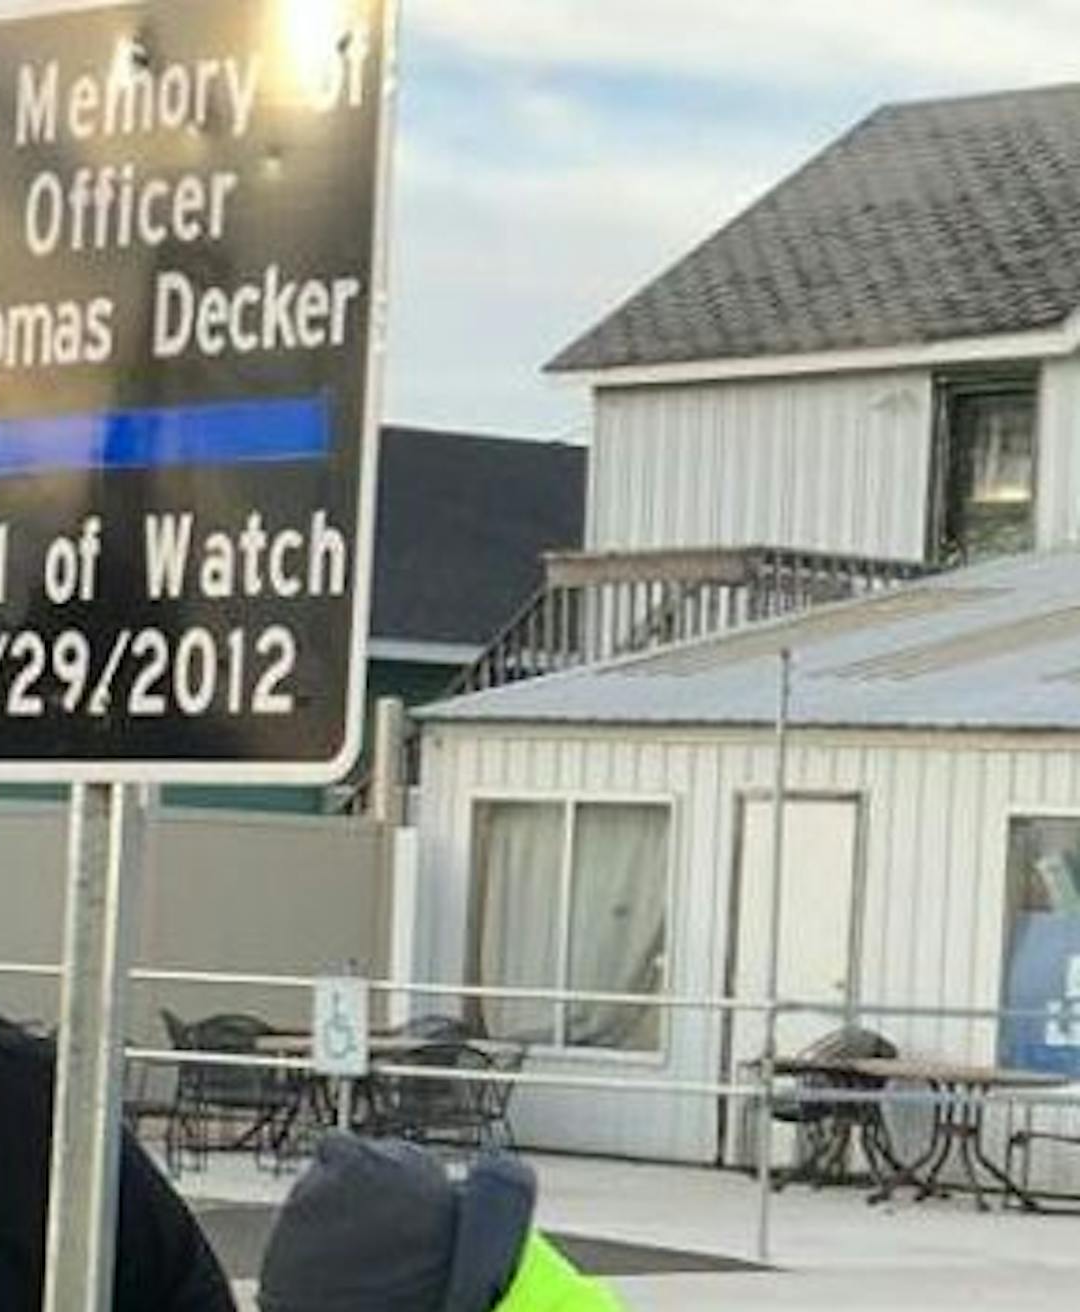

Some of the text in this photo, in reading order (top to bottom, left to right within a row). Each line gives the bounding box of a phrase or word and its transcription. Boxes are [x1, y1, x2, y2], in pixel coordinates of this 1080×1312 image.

[15, 53, 260, 146] Memory
[24, 160, 238, 255] Officer
[153, 264, 360, 357] Decker
[44, 516, 102, 604] of
[145, 509, 347, 599] Watch
